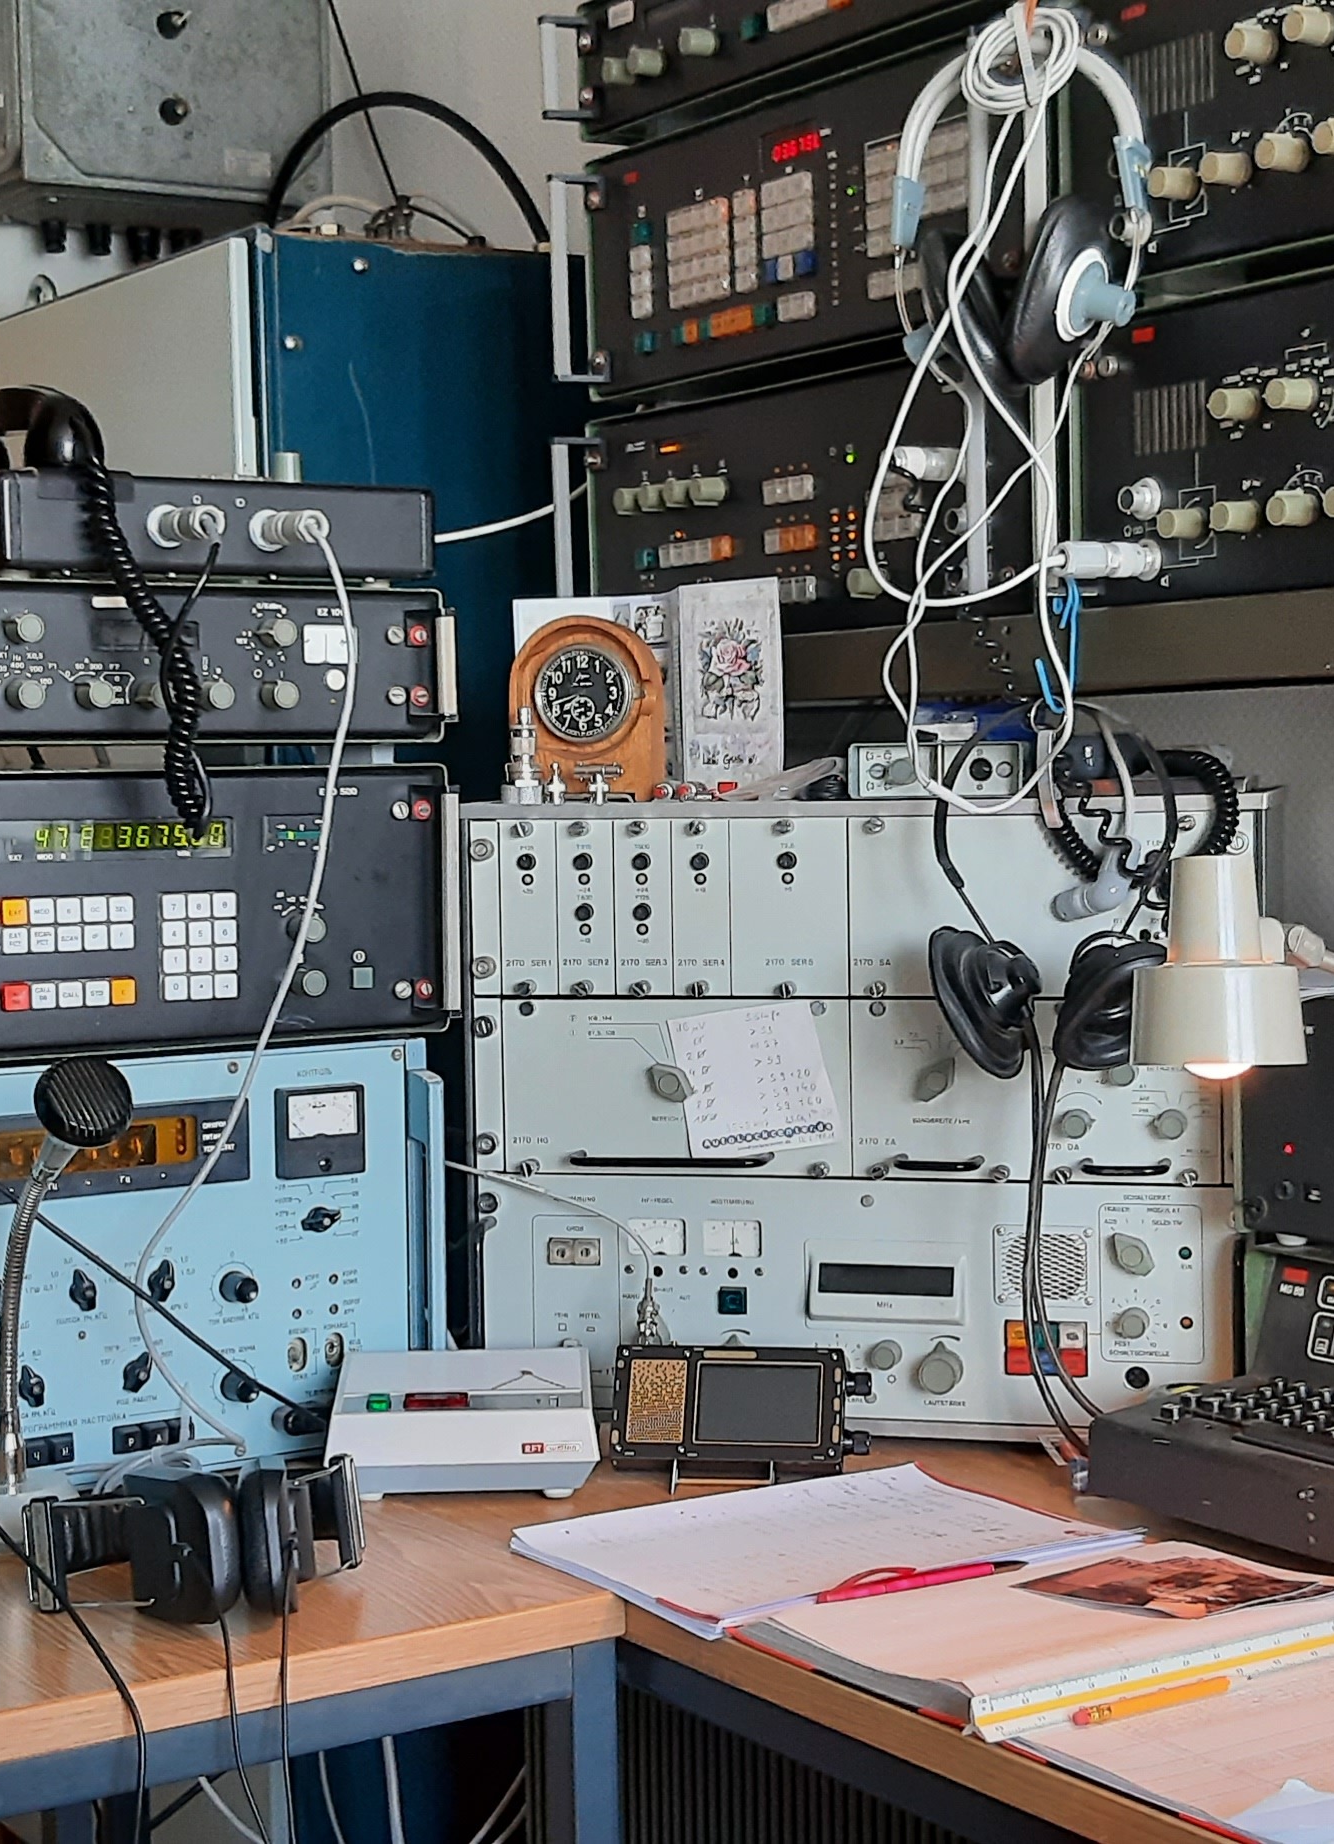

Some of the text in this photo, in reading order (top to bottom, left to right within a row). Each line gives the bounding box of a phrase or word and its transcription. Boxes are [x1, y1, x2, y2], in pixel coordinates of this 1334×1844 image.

[296, 1068, 333, 1078] КОНТРОЛЬ
[19, 1412, 127, 1434] РОГРАММНАЯ НАСТРОЙКА
